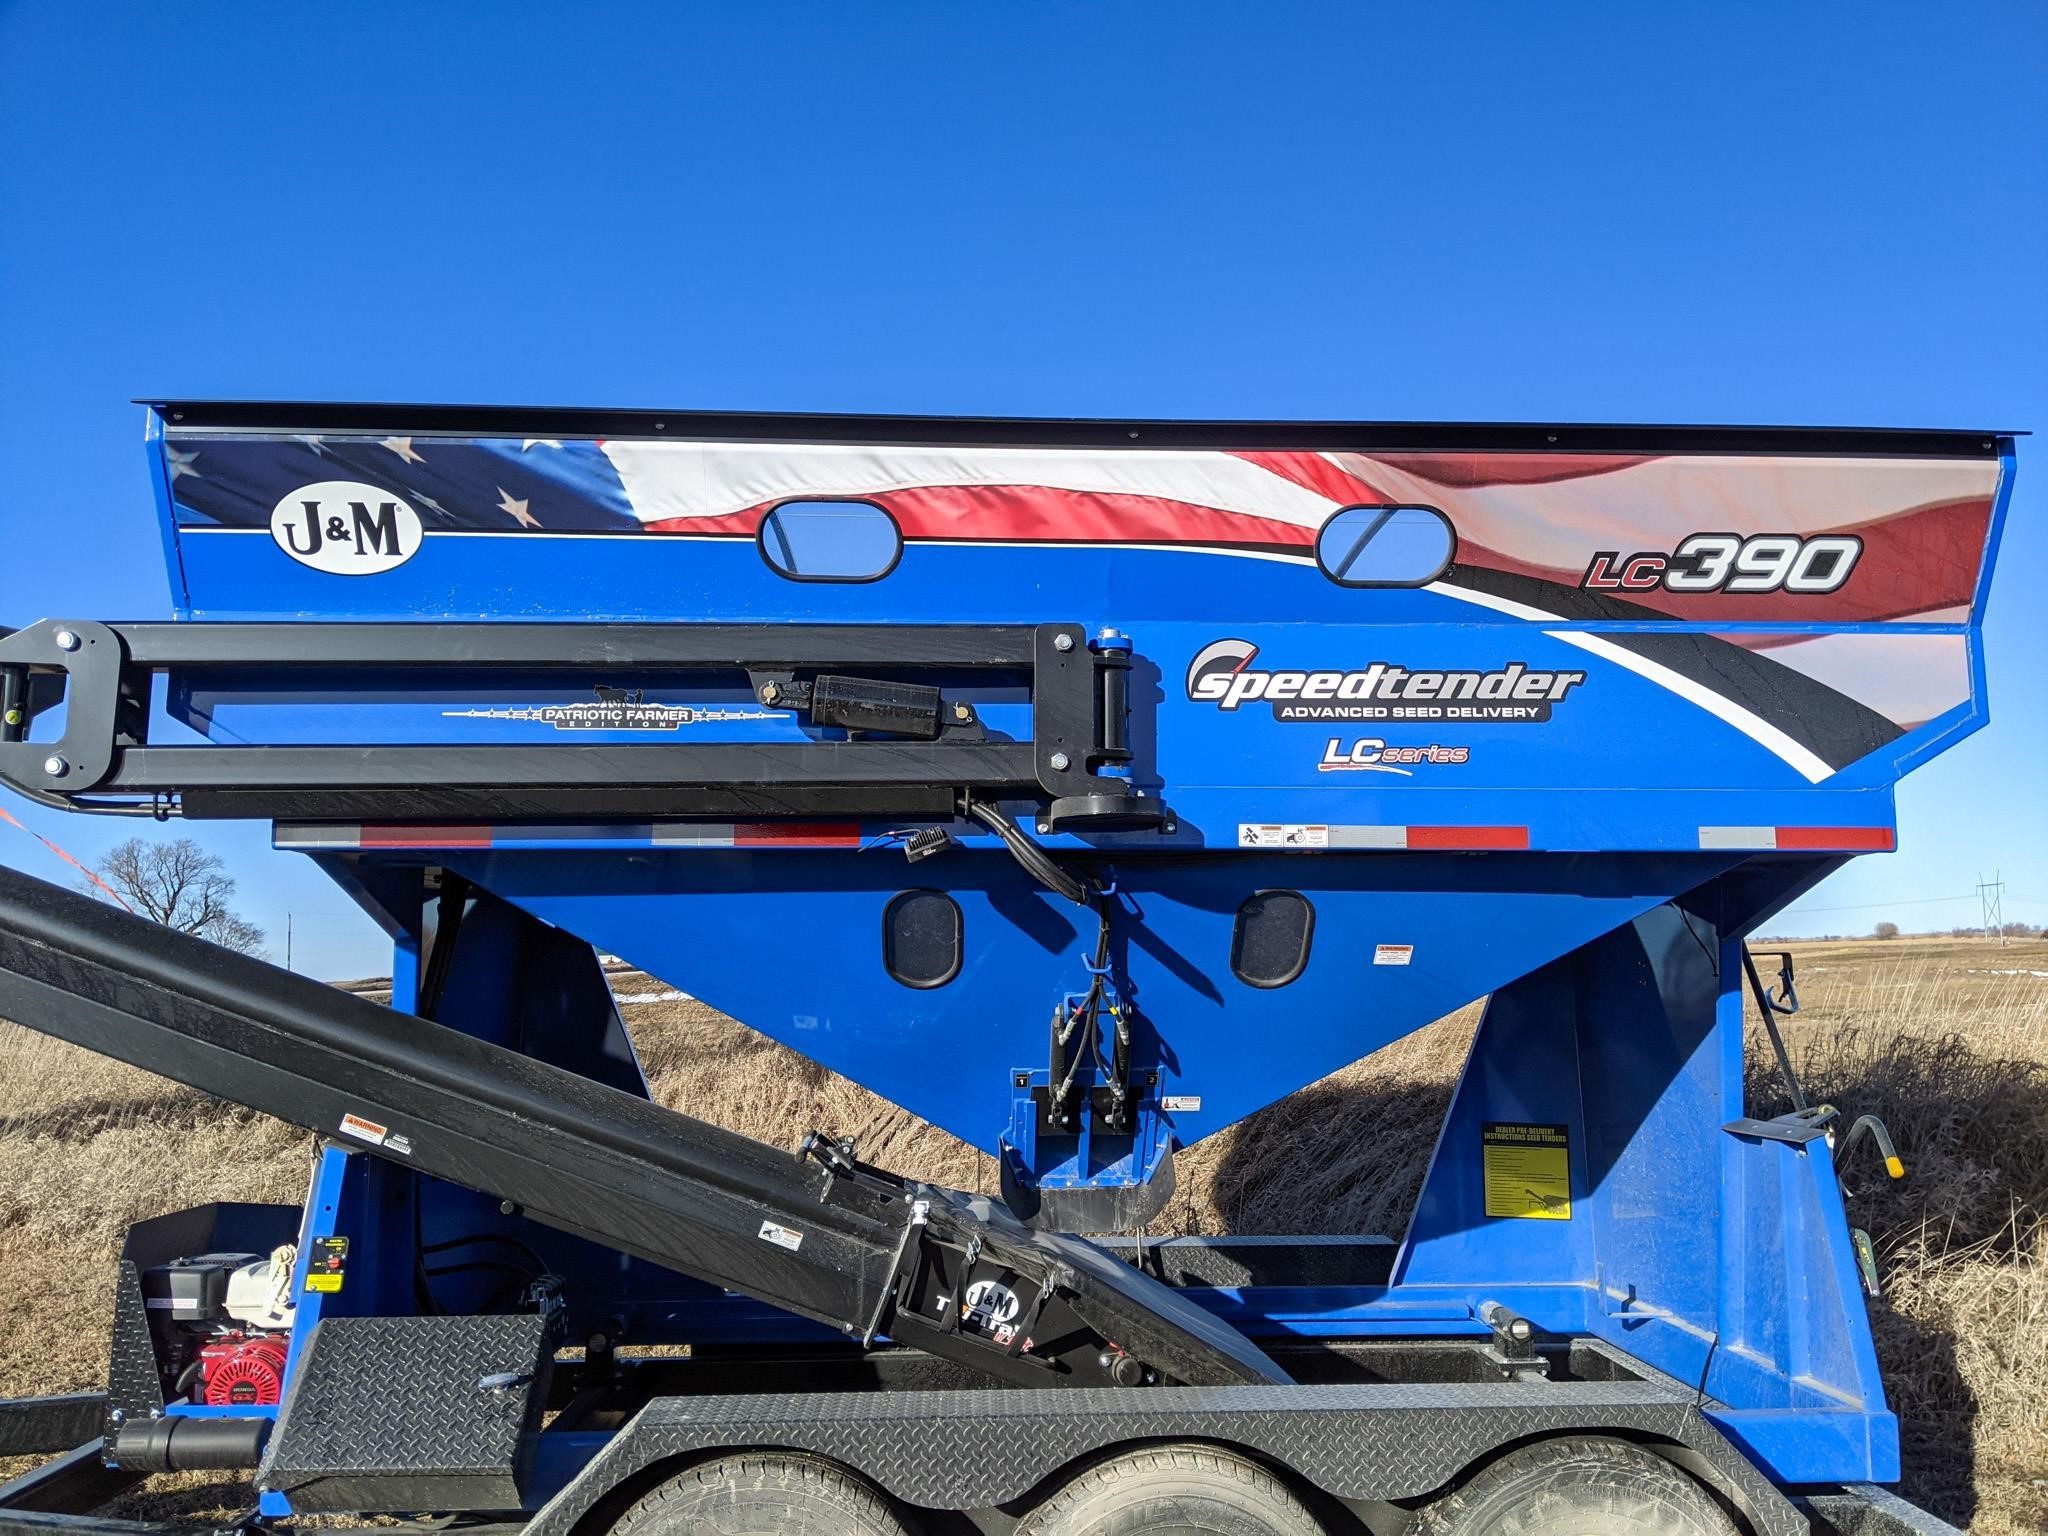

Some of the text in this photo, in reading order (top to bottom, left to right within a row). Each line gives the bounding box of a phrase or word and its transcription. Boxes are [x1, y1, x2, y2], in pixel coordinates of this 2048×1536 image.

[282, 501, 403, 556] J&M
[545, 709, 689, 721] PATRIOTIC FARMER
[1280, 706, 1540, 718] ADVANCED SEED DELIVERY
[352, 1118, 383, 1135] WARNING
[1516, 1127, 1555, 1135] PRE-DELIVERY
[1484, 1132, 1526, 1141] INSTRUCTIONS
[968, 1285, 1015, 1319] J&M
[232, 1393, 255, 1401] GX
